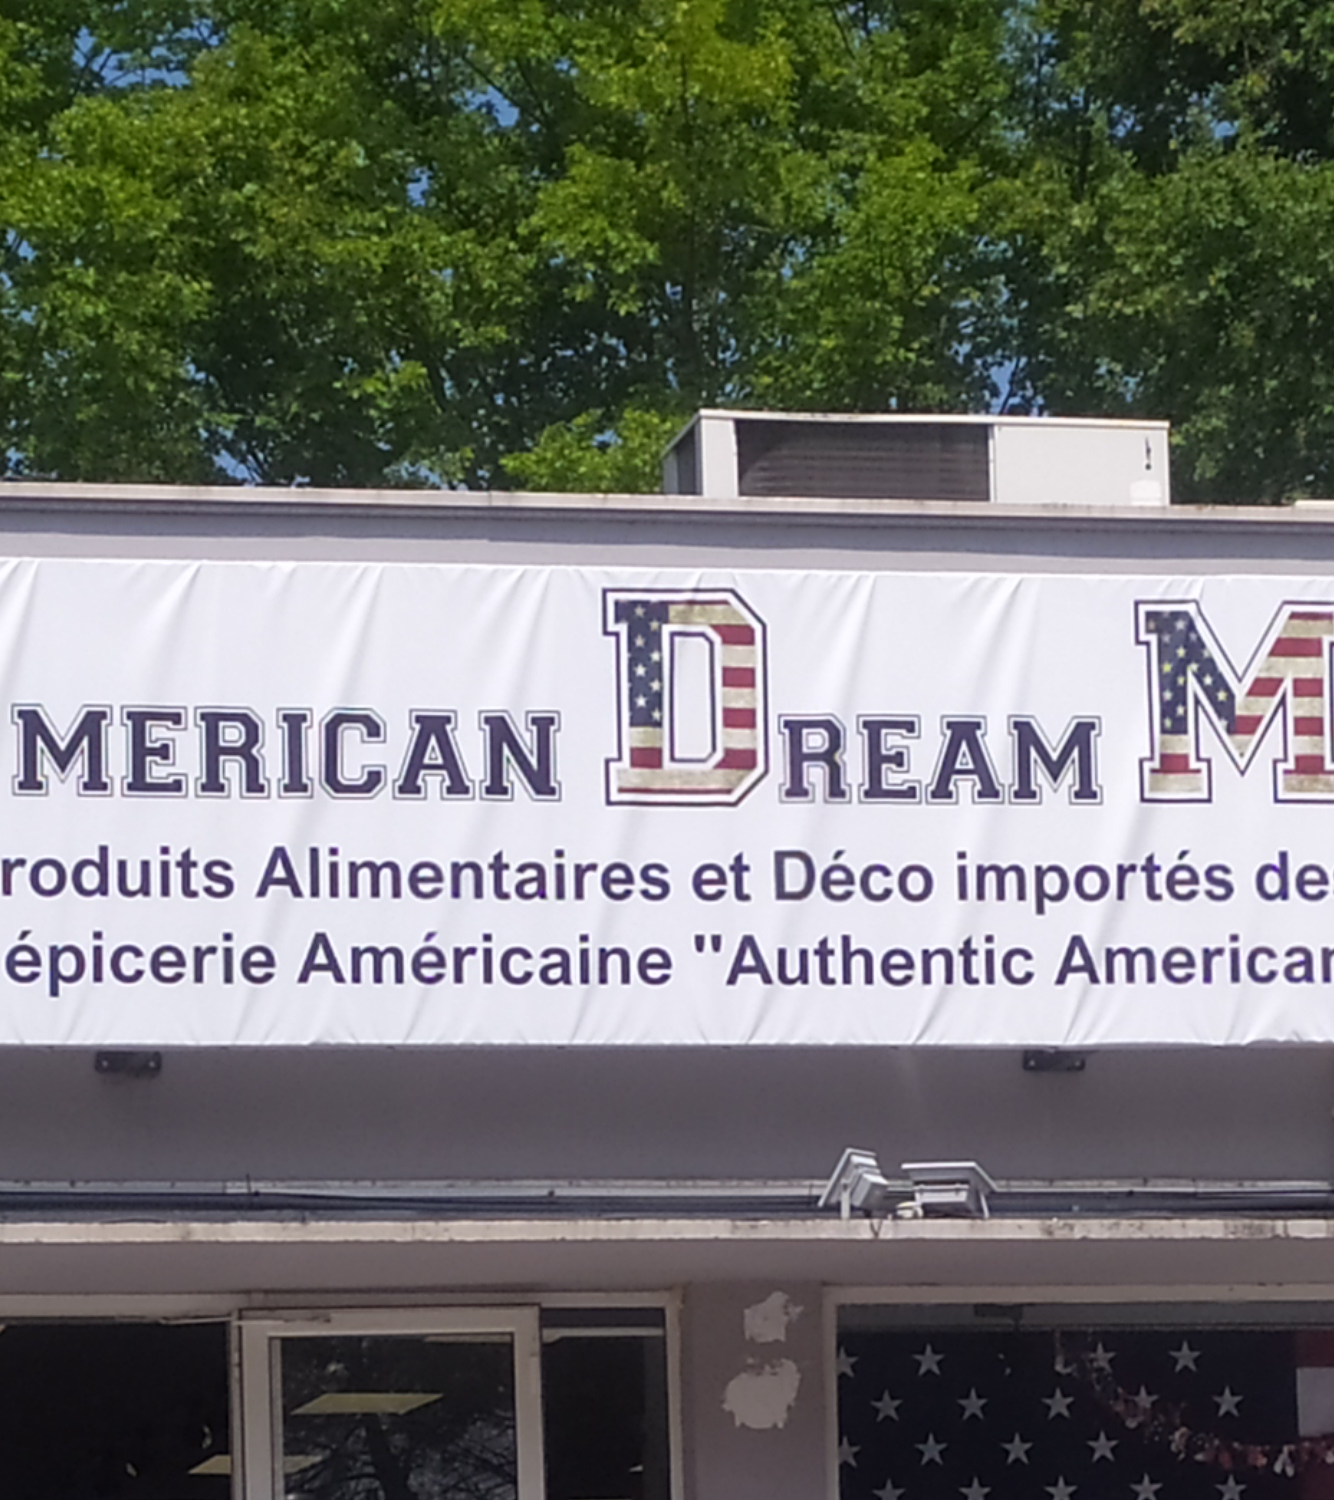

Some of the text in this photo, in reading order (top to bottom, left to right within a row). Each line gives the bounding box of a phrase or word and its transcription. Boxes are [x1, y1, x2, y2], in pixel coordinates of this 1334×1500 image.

[603, 588, 1103, 805] DREAM
[257, 846, 669, 902] Alimentaires
[692, 851, 751, 902] et
[774, 849, 933, 902] Déco
[957, 850, 1234, 915] importés
[4, 930, 276, 997] épicerie
[298, 932, 672, 985] Américaine
